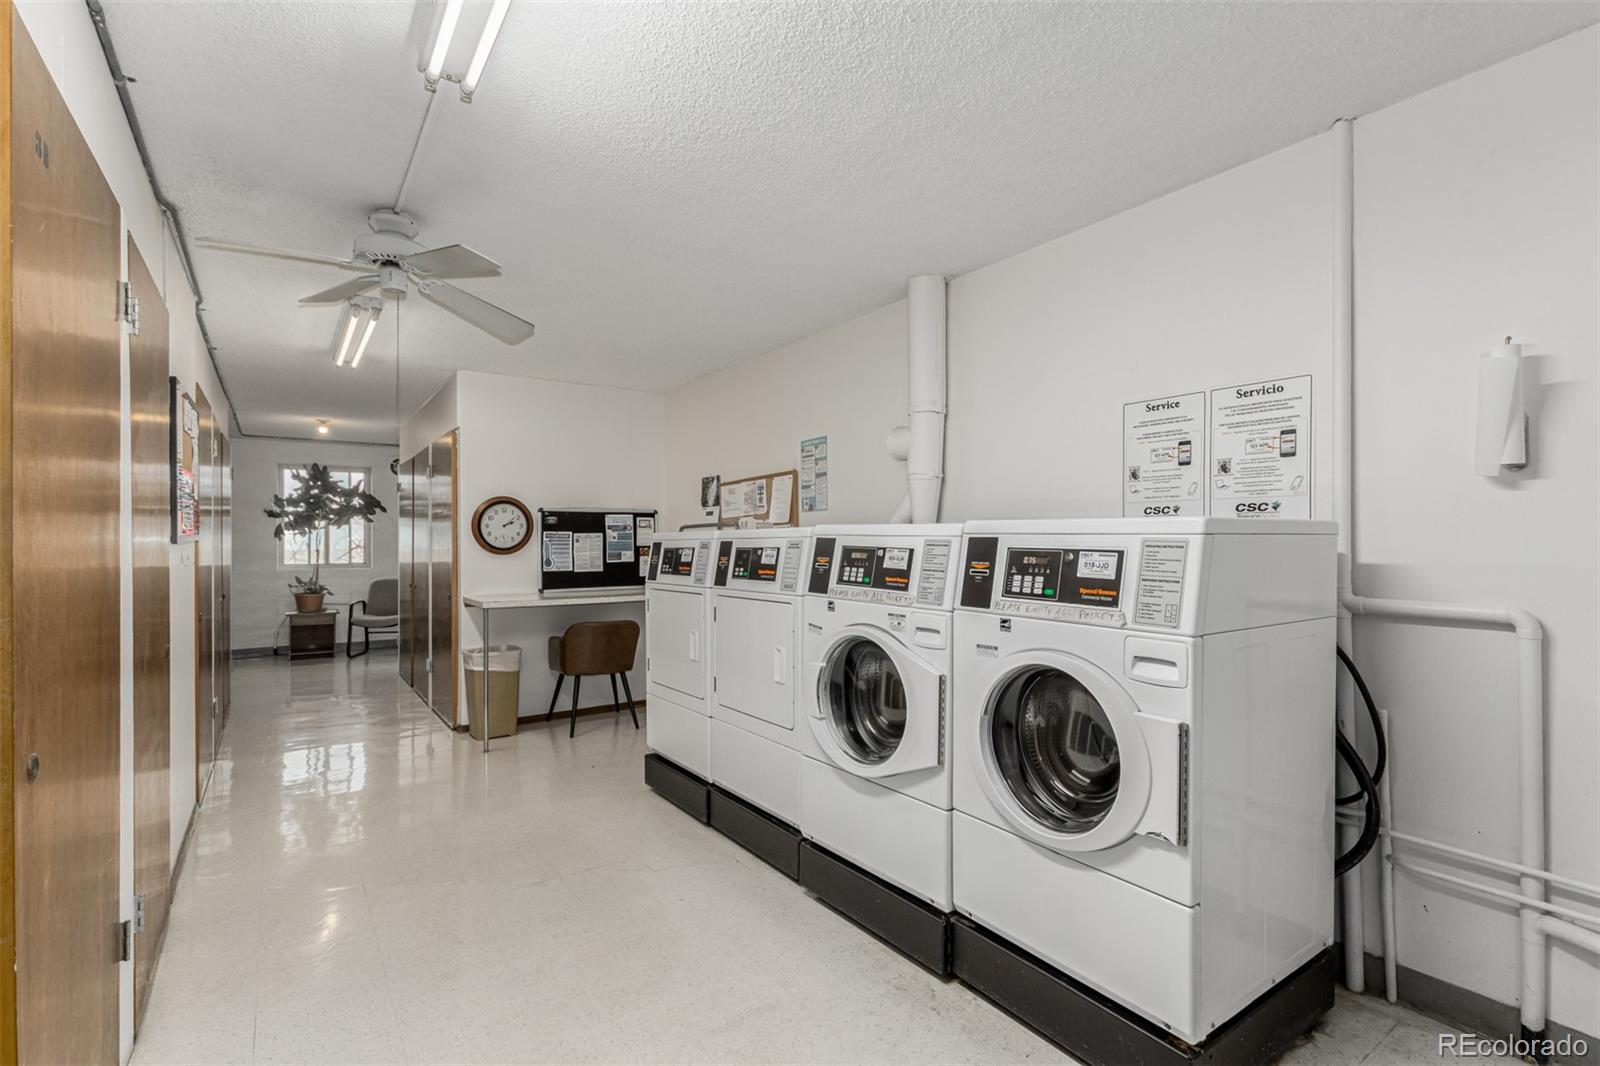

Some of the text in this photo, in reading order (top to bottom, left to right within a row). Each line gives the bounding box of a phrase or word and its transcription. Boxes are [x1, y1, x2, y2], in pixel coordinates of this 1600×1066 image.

[1236, 384, 1284, 399] Servicio
[1145, 400, 1180, 412] Service
[1144, 506, 1171, 515] CSC
[1235, 502, 1269, 513] CSC
[993, 602, 1021, 612] PLEASE
